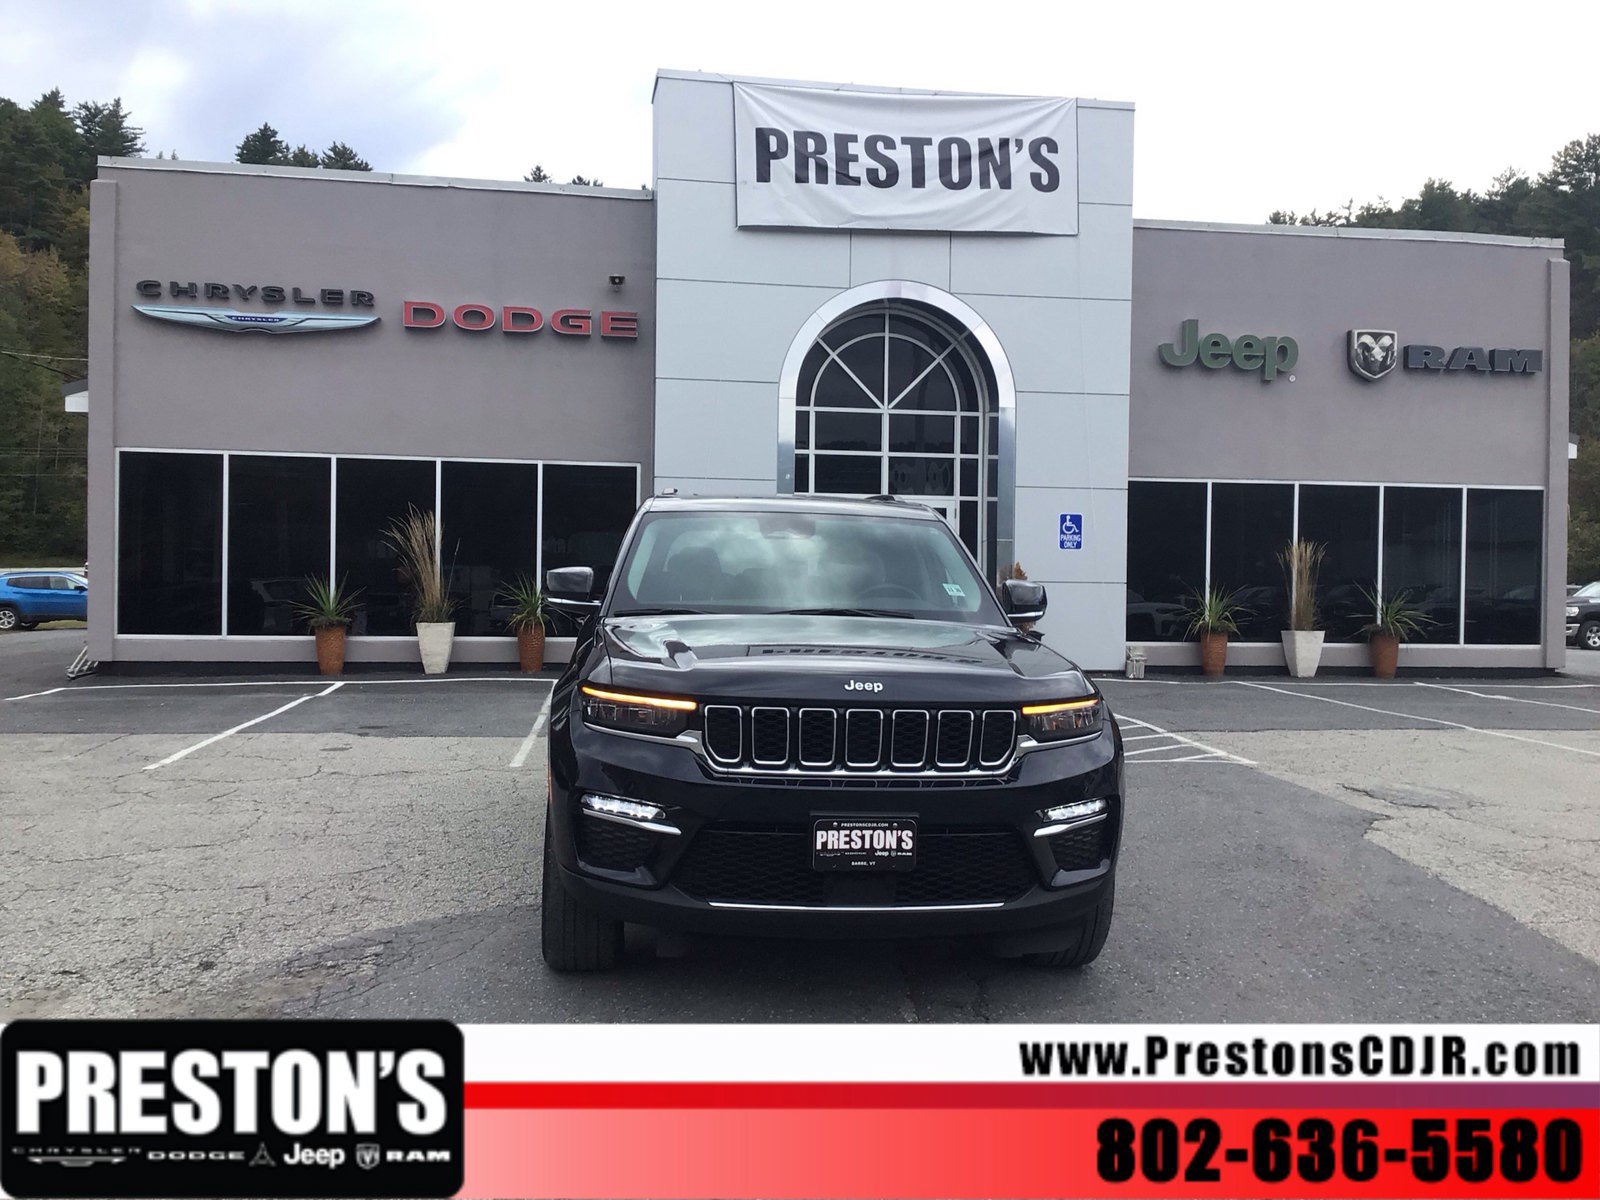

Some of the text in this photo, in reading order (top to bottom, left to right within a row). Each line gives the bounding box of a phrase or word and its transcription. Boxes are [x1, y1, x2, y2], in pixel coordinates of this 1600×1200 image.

[755, 127, 1061, 193] PRESTON'S
[135, 279, 375, 306] CHRYSLER
[403, 300, 638, 338] DODGE
[1158, 319, 1298, 382] Jeep
[1403, 344, 1543, 373] RAM
[1060, 534, 1081, 542] PARKING
[1063, 541, 1078, 549] ONLY
[844, 679, 883, 693] Jeep
[816, 829, 913, 850] PRESTON'S
